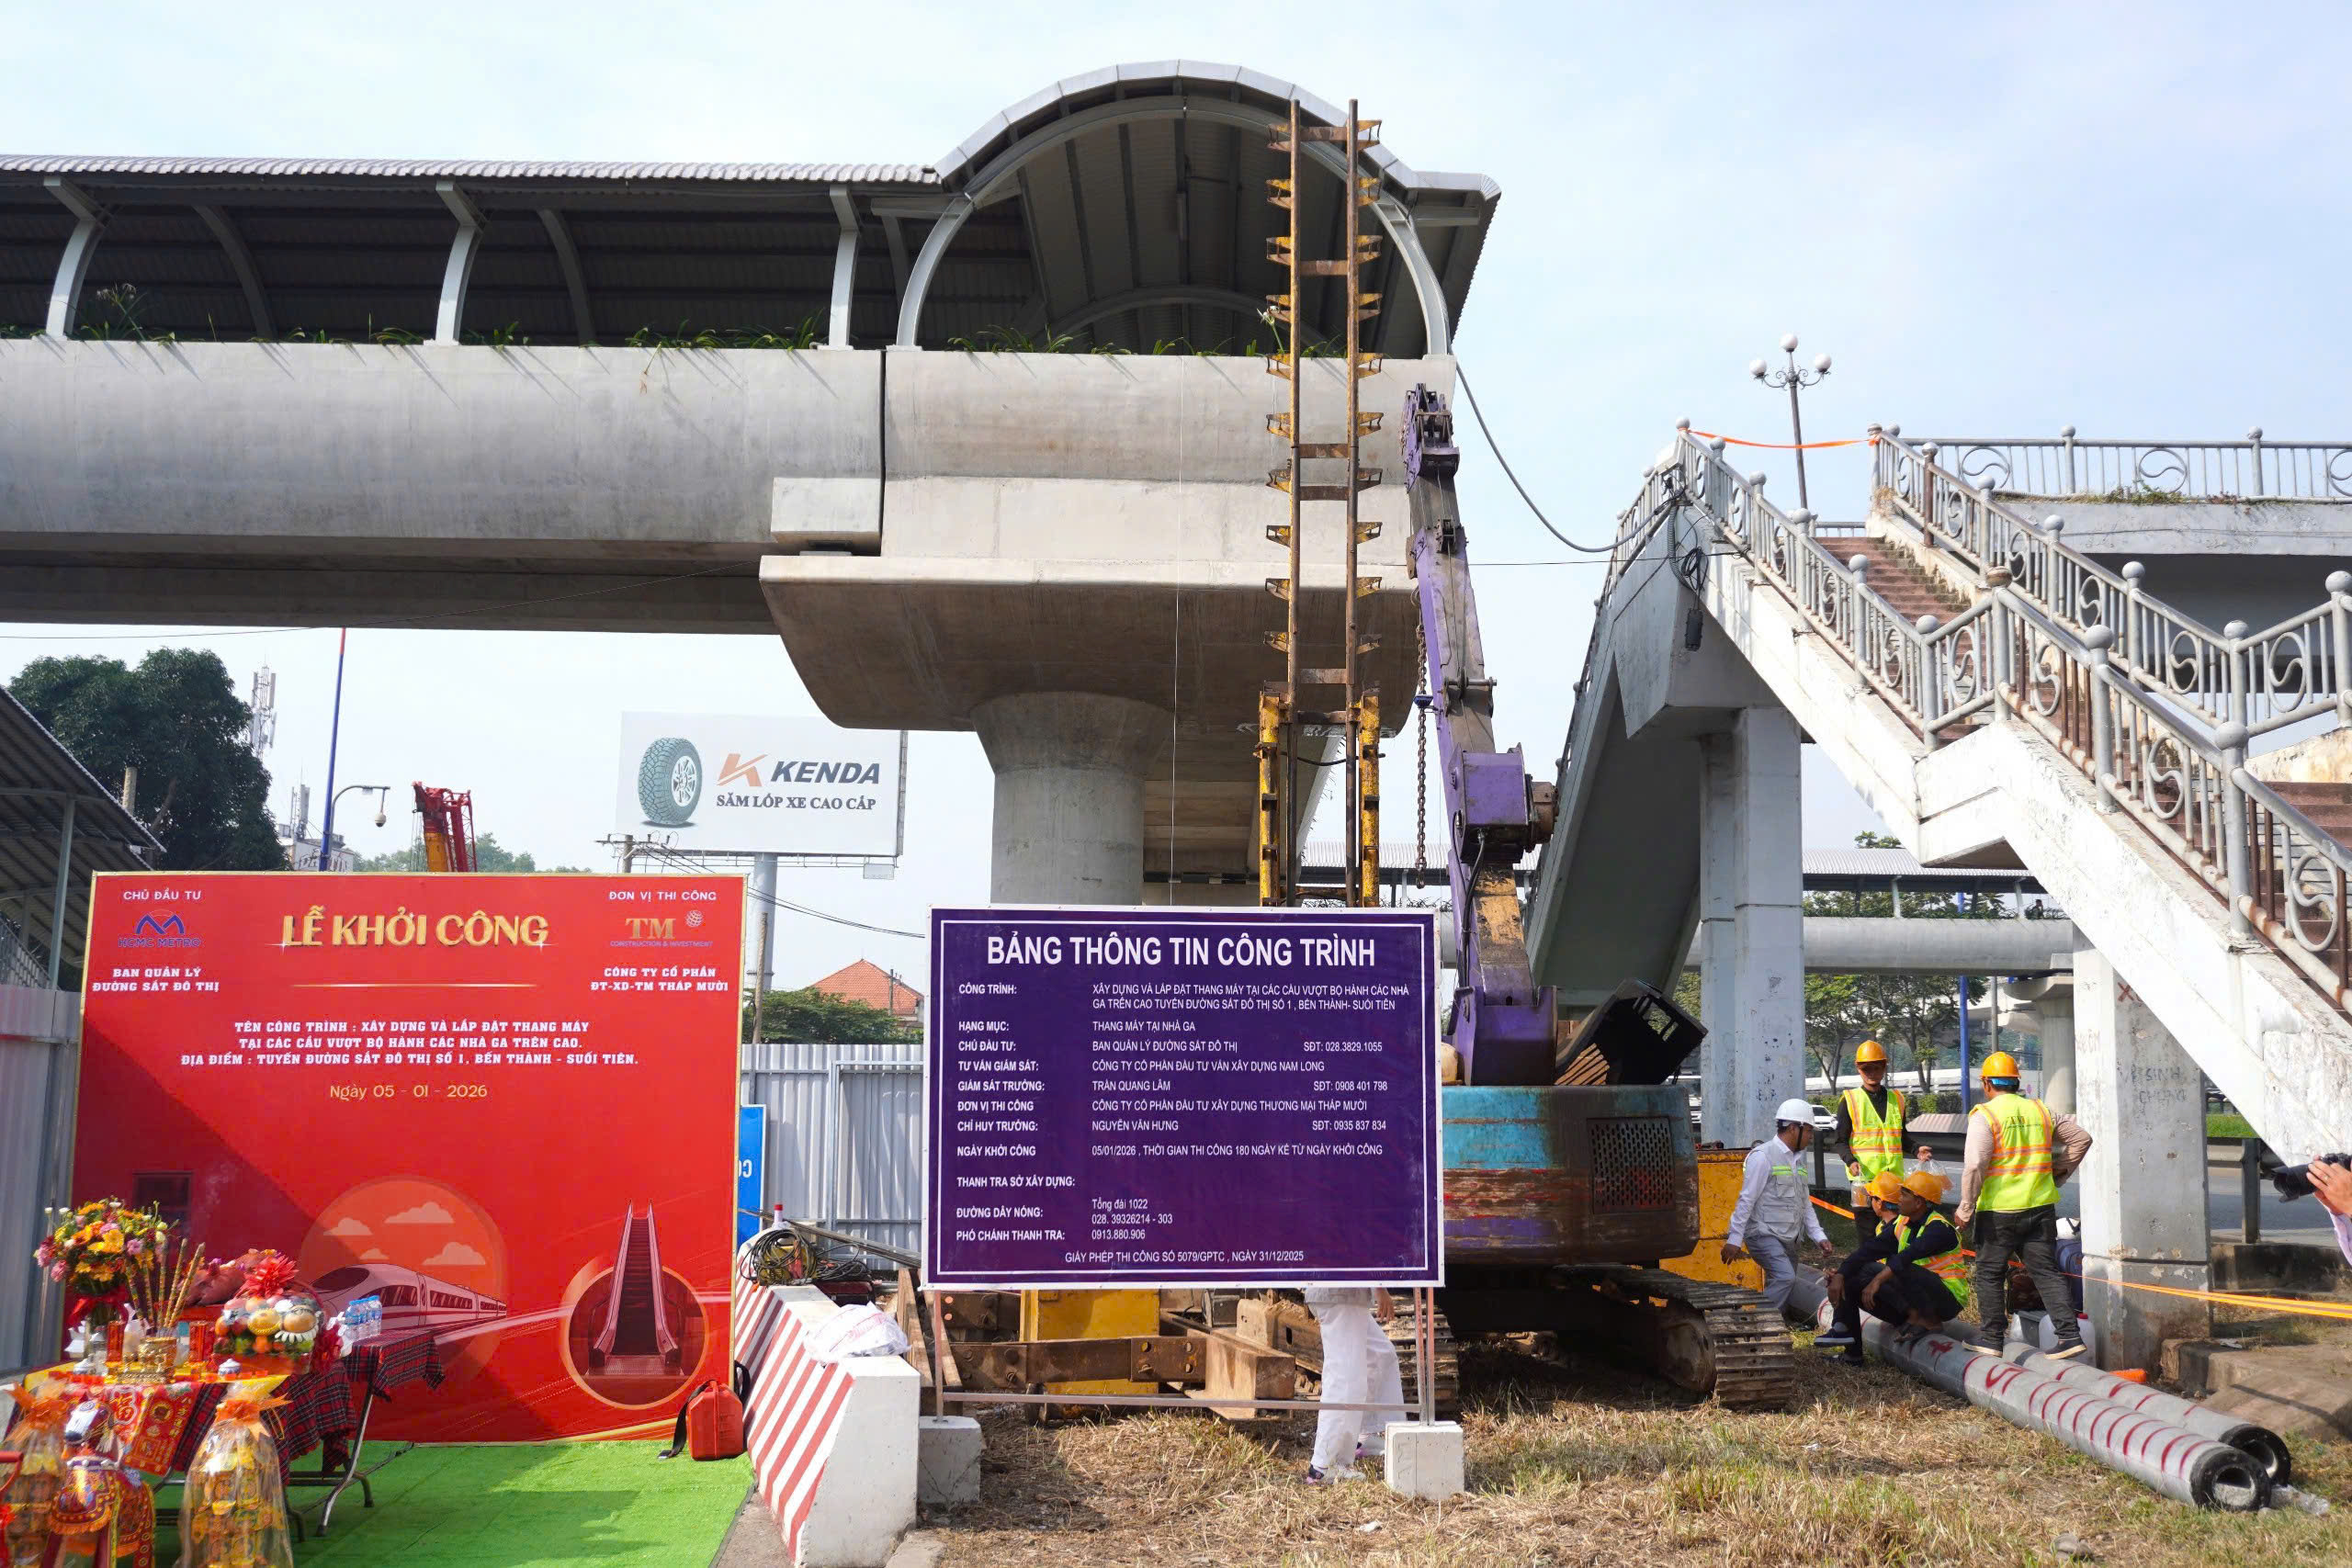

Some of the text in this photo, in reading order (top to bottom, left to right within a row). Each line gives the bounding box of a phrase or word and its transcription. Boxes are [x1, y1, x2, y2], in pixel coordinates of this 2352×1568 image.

[771, 761, 879, 784] KENDA
[717, 793, 750, 807] SĂM
[786, 797, 806, 808] XE
[810, 797, 842, 809] CAO
[123, 889, 149, 899] CHỦ
[185, 891, 201, 899] TƯ
[609, 890, 717, 902] ĐƠN VỊ THI CÔNG
[283, 906, 548, 946] LỄ KHỞI CÔNG
[625, 919, 676, 939] TM
[119, 938, 201, 947] HCMC METRO
[989, 931, 1374, 966] BẢNG THÔNG TIN CÔNG TRÌNH
[113, 966, 201, 977] BAN QUẢN LÝ
[605, 966, 637, 976] CÔNG
[641, 968, 658, 976] TY
[173, 981, 190, 990] ĐÔ
[196, 982, 219, 992] THỊ
[591, 982, 653, 990] ĐT-XD-TM
[658, 981, 692, 990] THÁP
[959, 982, 985, 994] CÔNG
[235, 1021, 261, 1032] TÊN
[266, 1021, 300, 1032] CÔNG
[306, 1021, 347, 1032] TRÌNH
[361, 1020, 386, 1032] XÂY
[431, 1020, 447, 1031] VÀ
[513, 1021, 557, 1032] THANG
[562, 1021, 588, 1032] MÁY
[959, 1021, 984, 1032] HẠNG
[239, 1039, 261, 1050] TẠI
[266, 1036, 291, 1048] CÁC
[389, 1036, 424, 1047] HÀNH
[430, 1036, 454, 1047] CÁC
[459, 1036, 486, 1047] NHÀ
[492, 1038, 507, 1047] GA
[513, 1036, 548, 1047] TRÊN
[958, 1039, 978, 1051] CHỦ
[1326, 1042, 1382, 1051] 028.3829.1055
[181, 1055, 204, 1066] ĐỊA
[385, 1053, 402, 1064] ĐÔ
[408, 1054, 430, 1066] THỊ
[506, 1052, 551, 1064] THÀNH
[958, 1061, 971, 1071] TƯ
[994, 1059, 1016, 1071] GIÁM
[958, 1079, 980, 1091] GIÁM
[983, 1079, 1001, 1091] SÁT
[1118, 1081, 1150, 1090] QUANG
[1153, 1078, 1170, 1090] LÂM
[1336, 1081, 1354, 1090] 0908
[1357, 1081, 1370, 1090] 401
[1374, 1081, 1387, 1090] 798
[331, 1084, 368, 1101] Ngày
[373, 1085, 394, 1097] 05
[447, 1085, 487, 1097] 2026
[957, 1099, 1034, 1113] ĐƠN VỊ THI CÔNG
[957, 1119, 973, 1132] CHỈ
[976, 1122, 994, 1131] HUY
[1132, 1119, 1149, 1130] VĂN
[1152, 1121, 1178, 1131] HƯNG
[1334, 1121, 1353, 1130] 0935
[1356, 1121, 1369, 1130] 837
[1373, 1121, 1385, 1130] 834
[957, 1145, 982, 1156] NGÀY
[1010, 1145, 1035, 1156] CÔNG
[1092, 1145, 1136, 1156] 05/01/2026
[957, 1178, 987, 1187] THANH
[989, 1177, 1008, 1187] TRA
[1025, 1175, 1044, 1186] XÂY
[1114, 1200, 1125, 1209] đài
[1129, 1199, 1148, 1209] 1022
[994, 1205, 1012, 1217] DÂY
[1112, 1213, 1150, 1224] 39326214
[1158, 1213, 1172, 1224] 303
[956, 1229, 976, 1240] PHÓ
[978, 1229, 1009, 1240] CHÁNH
[1012, 1231, 1042, 1240] THANH
[1091, 1229, 1145, 1239] 0913.880.906
[1090, 1251, 1114, 1264] PHÉP
[1116, 1252, 1130, 1262] THI
[1133, 1251, 1159, 1262] CÔNG
[1178, 1251, 1224, 1261] 5079/GPTC
[1232, 1249, 1257, 1261] NGÀY
[1260, 1251, 1304, 1261] 31/12/2025
